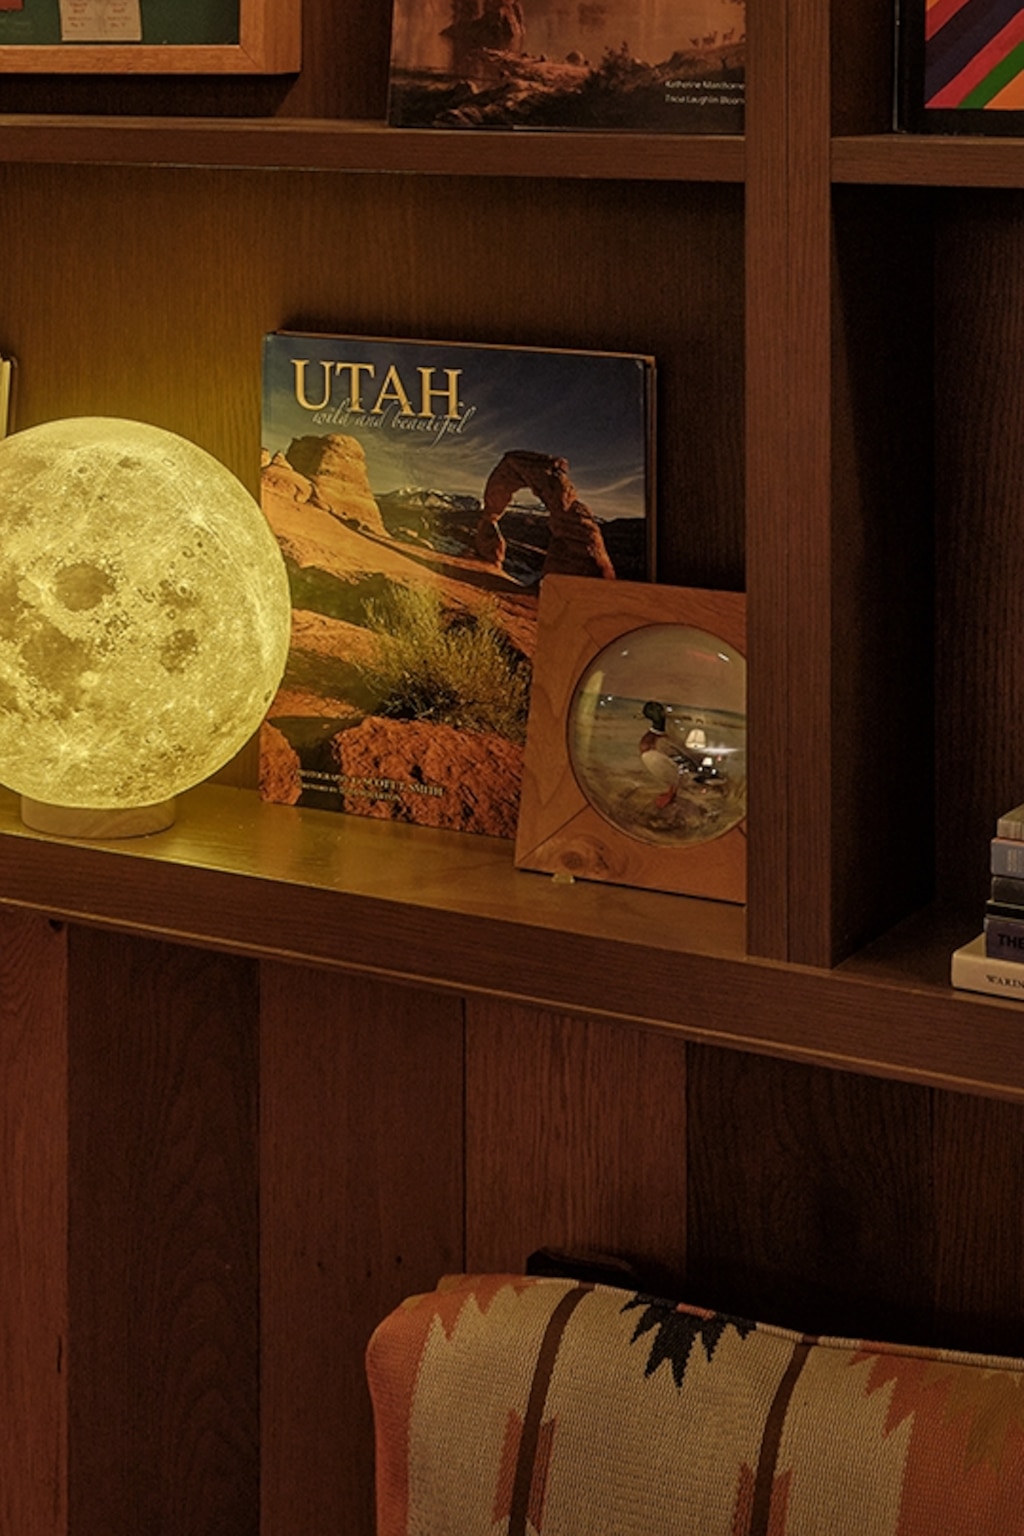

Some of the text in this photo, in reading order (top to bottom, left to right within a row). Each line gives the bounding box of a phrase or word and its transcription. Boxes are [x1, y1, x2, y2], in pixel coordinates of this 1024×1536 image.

[290, 358, 462, 419] UTAH
[312, 398, 478, 449] wild and beautiful
[409, 783, 443, 796] SMITH
[997, 932, 1024, 950] THE
